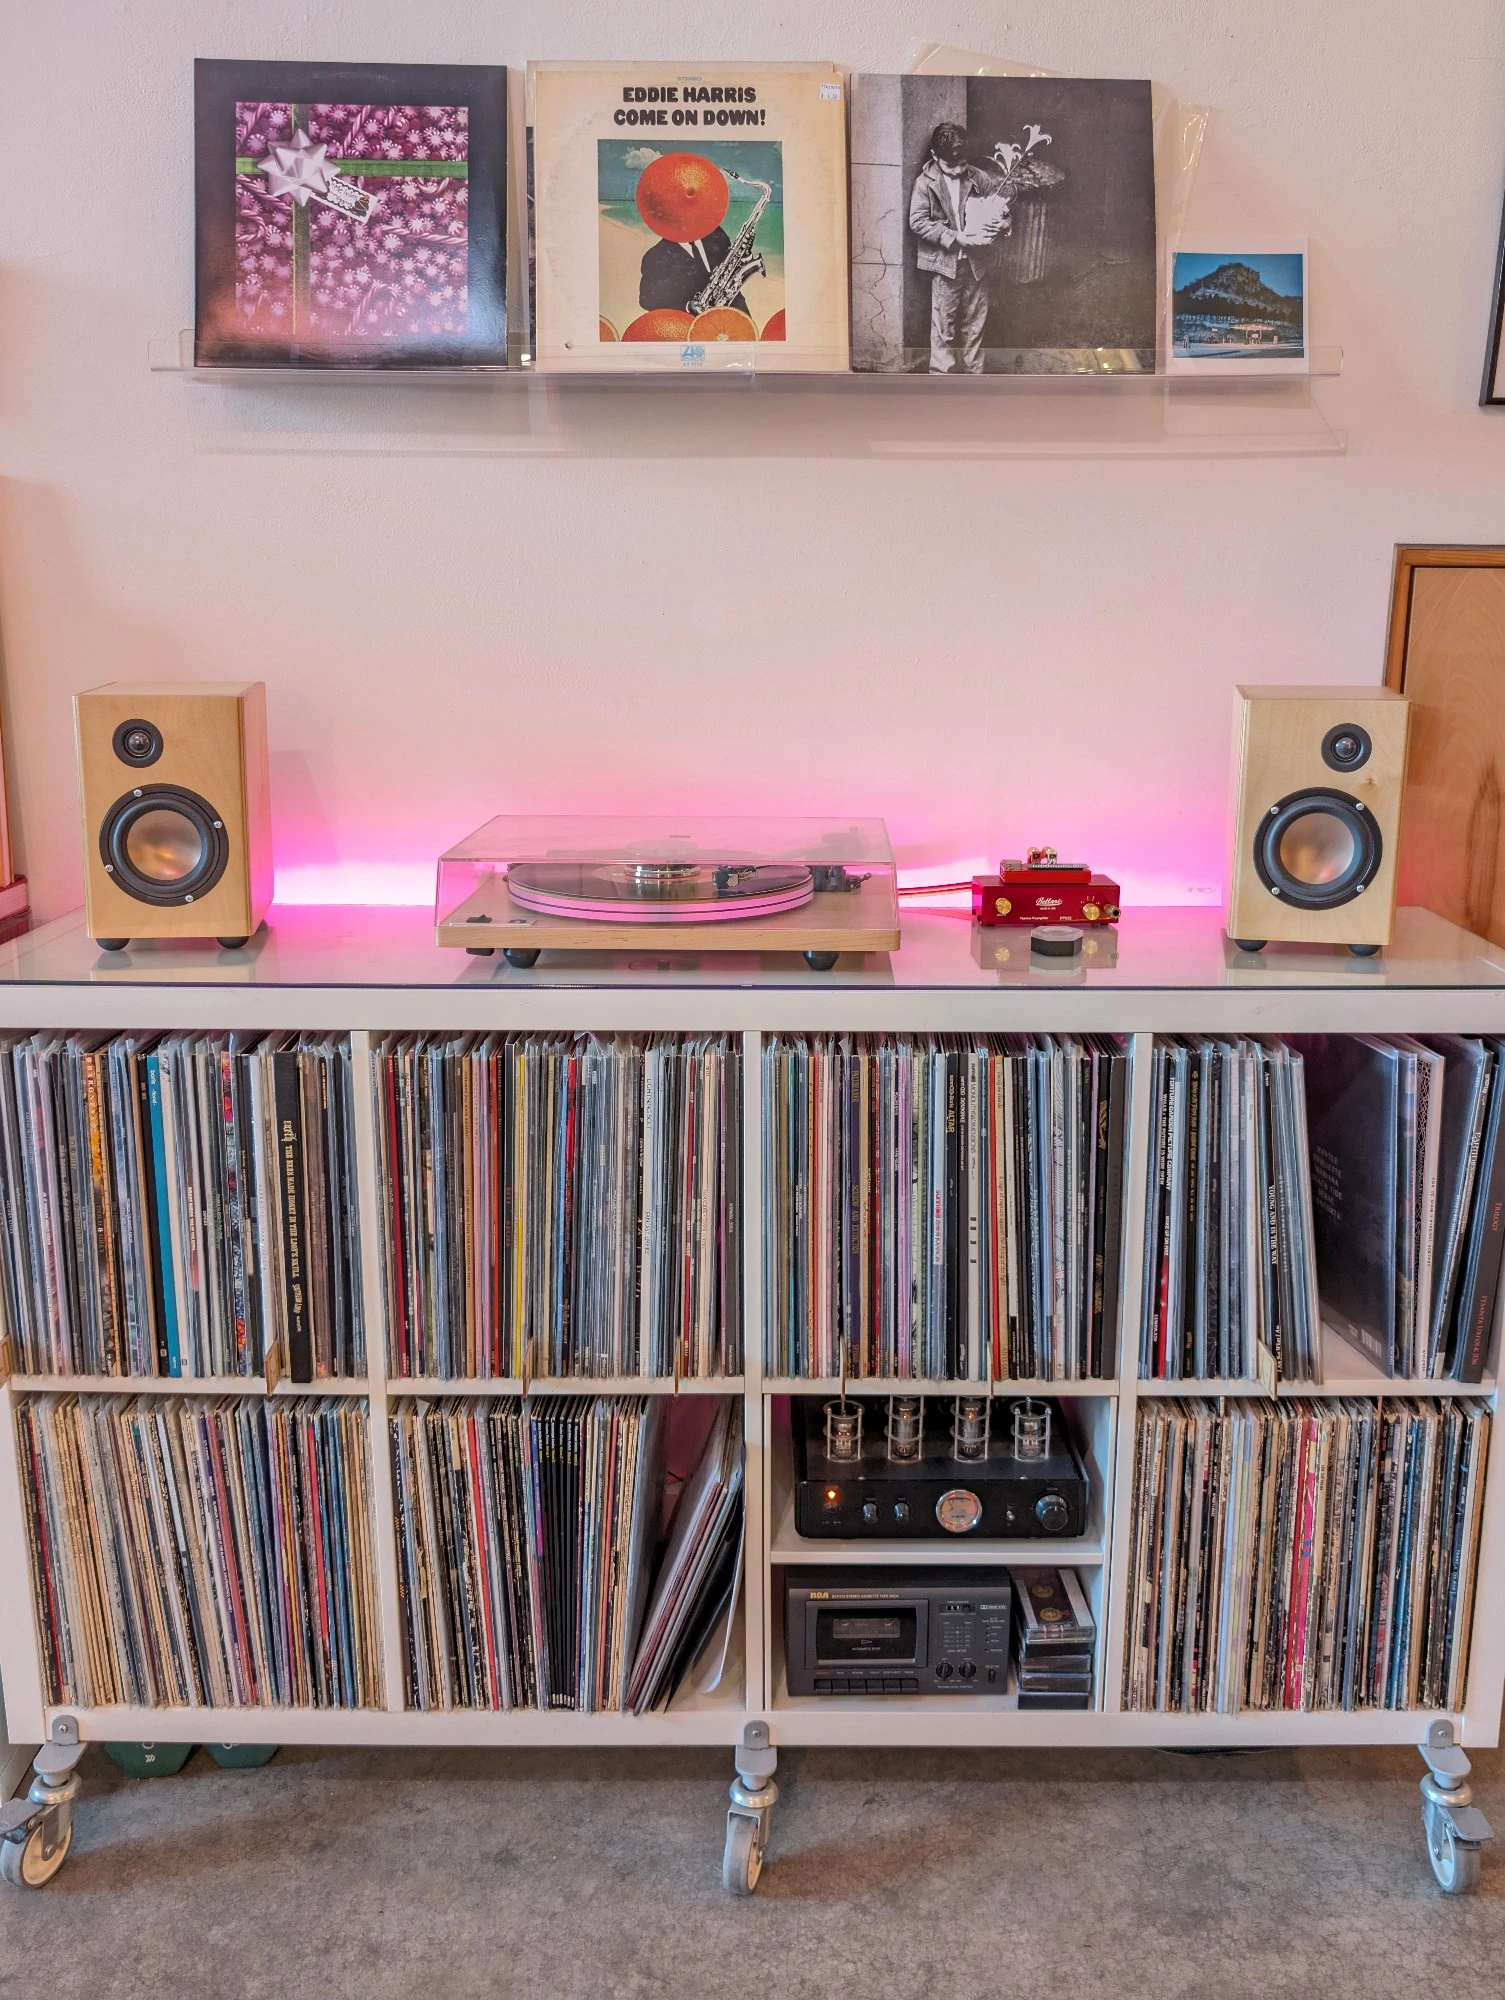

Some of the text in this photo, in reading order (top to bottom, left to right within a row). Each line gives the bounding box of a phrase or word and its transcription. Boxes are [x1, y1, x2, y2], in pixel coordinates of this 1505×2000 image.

[623, 87, 756, 103] EDDIE HARRIS
[614, 109, 766, 126] COME ON DOWN!
[947, 1109, 955, 1132] ALTAR
[285, 1145, 293, 1159] THE
[1471, 1132, 1481, 1157] EARTH
[286, 1160, 294, 1176] BEES
[287, 1177, 295, 1194] MADE
[288, 1195, 297, 1215] HONEY
[1492, 1201, 1502, 1231] TRILOGY
[289, 1223, 298, 1237] THE
[290, 1238, 299, 1258] LION'S
[291, 1258, 300, 1278] SKULL
[1477, 1295, 1488, 1324] PESANTA
